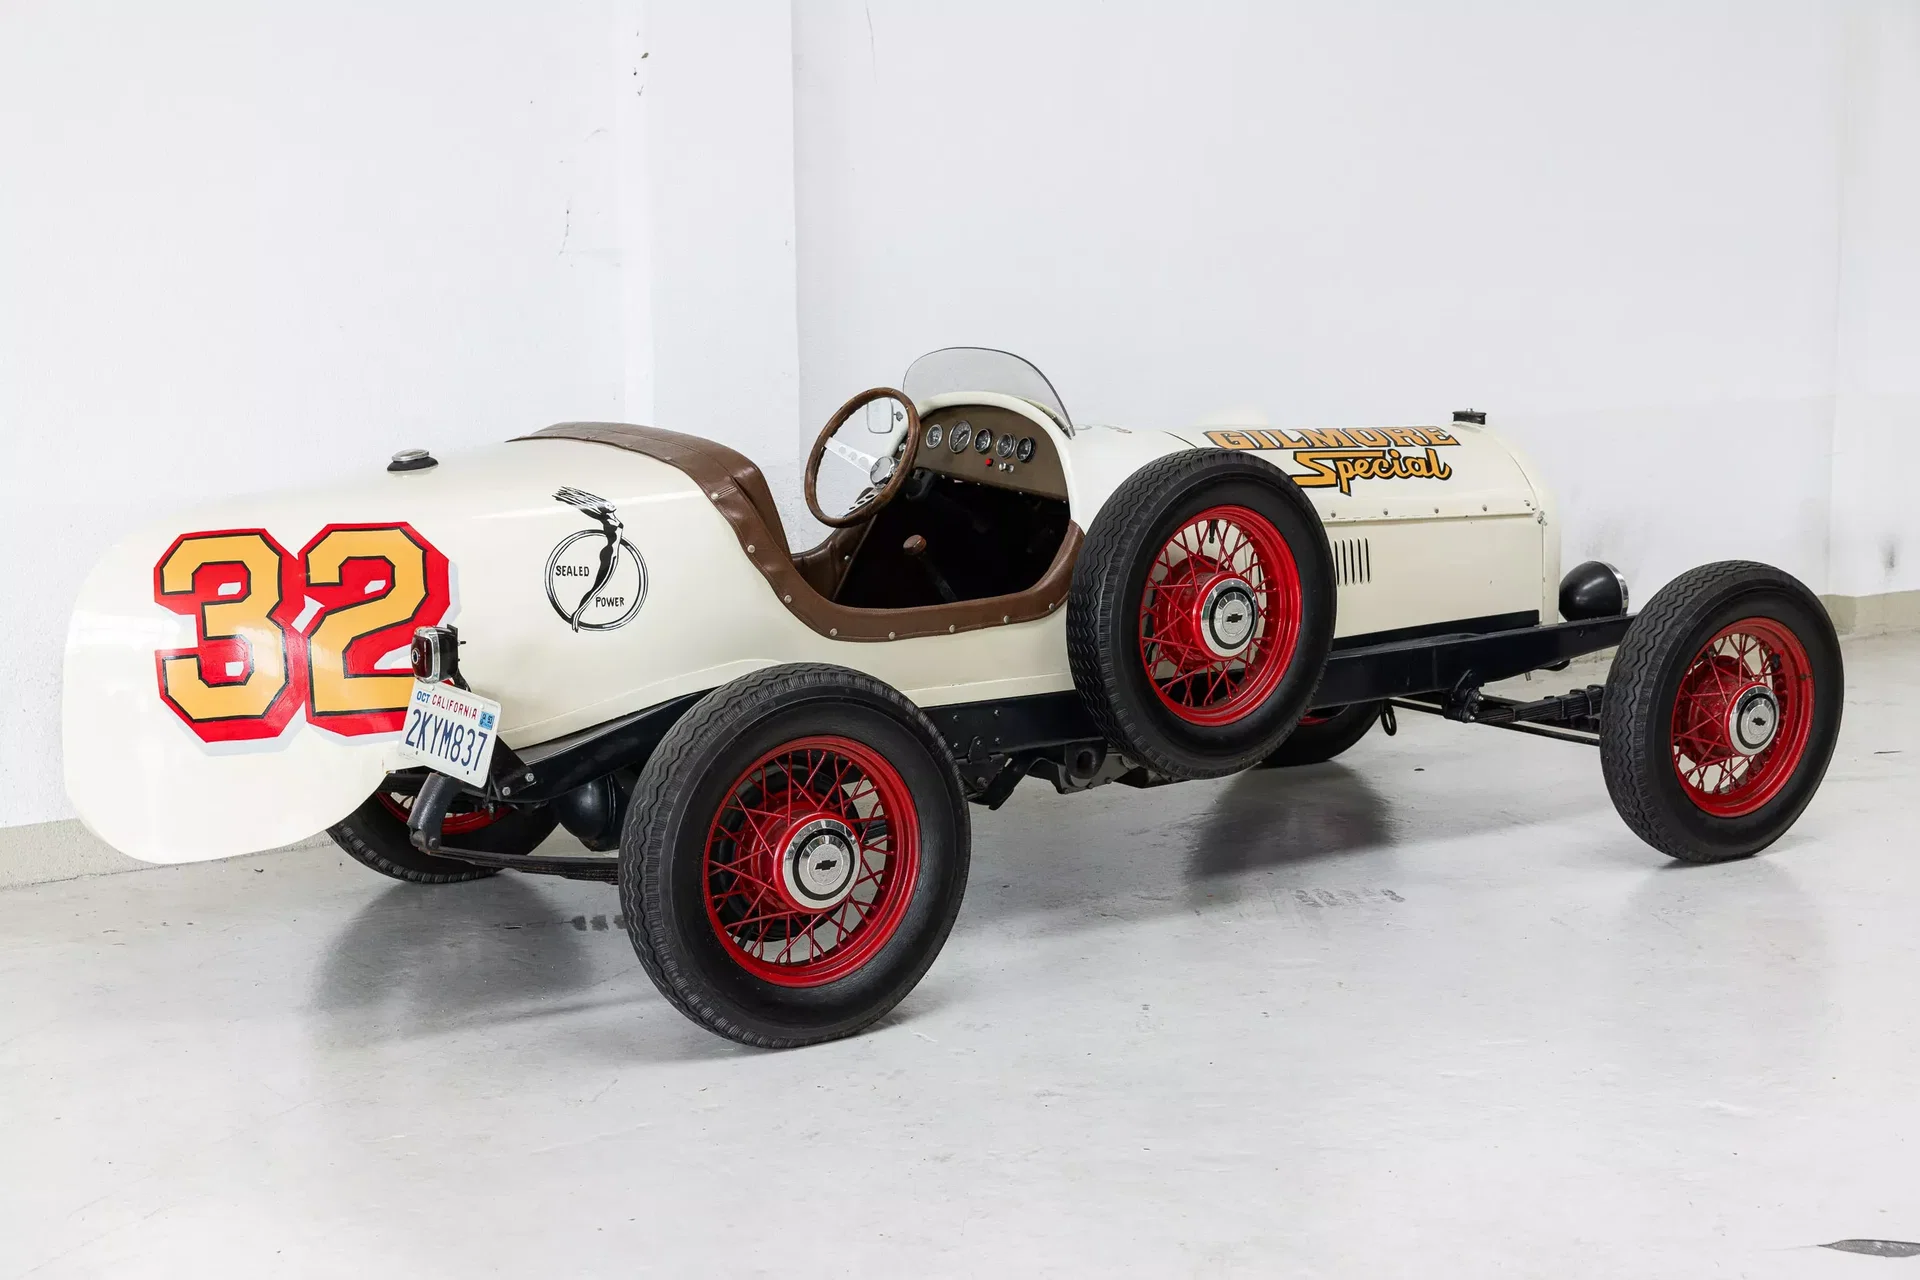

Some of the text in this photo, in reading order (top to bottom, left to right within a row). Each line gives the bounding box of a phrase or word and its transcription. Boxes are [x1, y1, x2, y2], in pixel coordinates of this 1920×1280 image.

[1203, 426, 1461, 450] GILMORE
[1291, 448, 1452, 497] Special
[556, 565, 590, 577] SEALED
[595, 596, 625, 608] POWER
[154, 522, 450, 742] 32
[416, 690, 478, 720] OCT CALIFORNIA
[405, 709, 488, 771] 2KYM837
